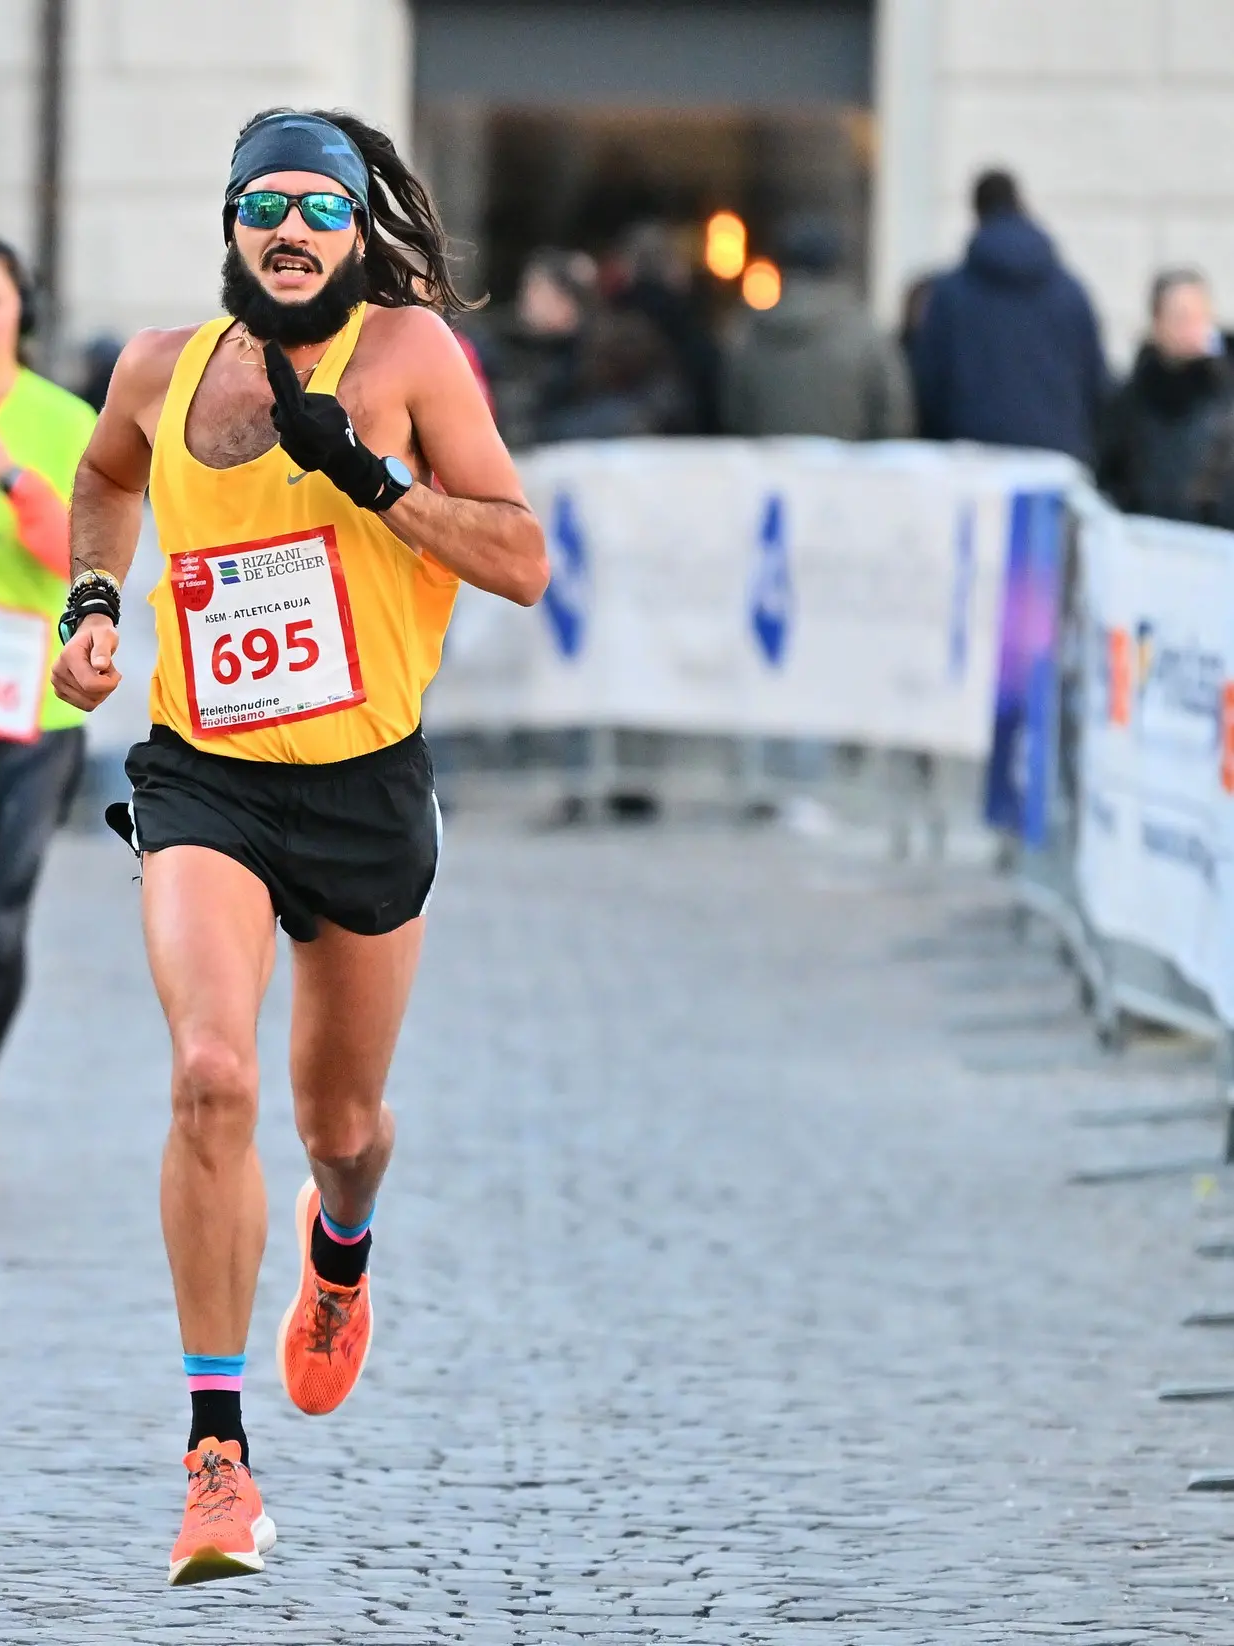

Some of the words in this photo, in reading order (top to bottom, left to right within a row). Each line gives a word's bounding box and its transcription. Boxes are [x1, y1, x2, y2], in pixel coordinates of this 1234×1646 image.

[241, 547, 302, 570] RIZZANI
[244, 569, 264, 582] DE
[267, 555, 326, 578] ECCHER
[205, 612, 227, 624] ASEM
[233, 602, 282, 620] ATLETICA
[284, 596, 312, 611] BUJA
[211, 618, 320, 685] 695
[200, 696, 281, 718] #telethonudine
[201, 709, 266, 728] #noicisiamo
